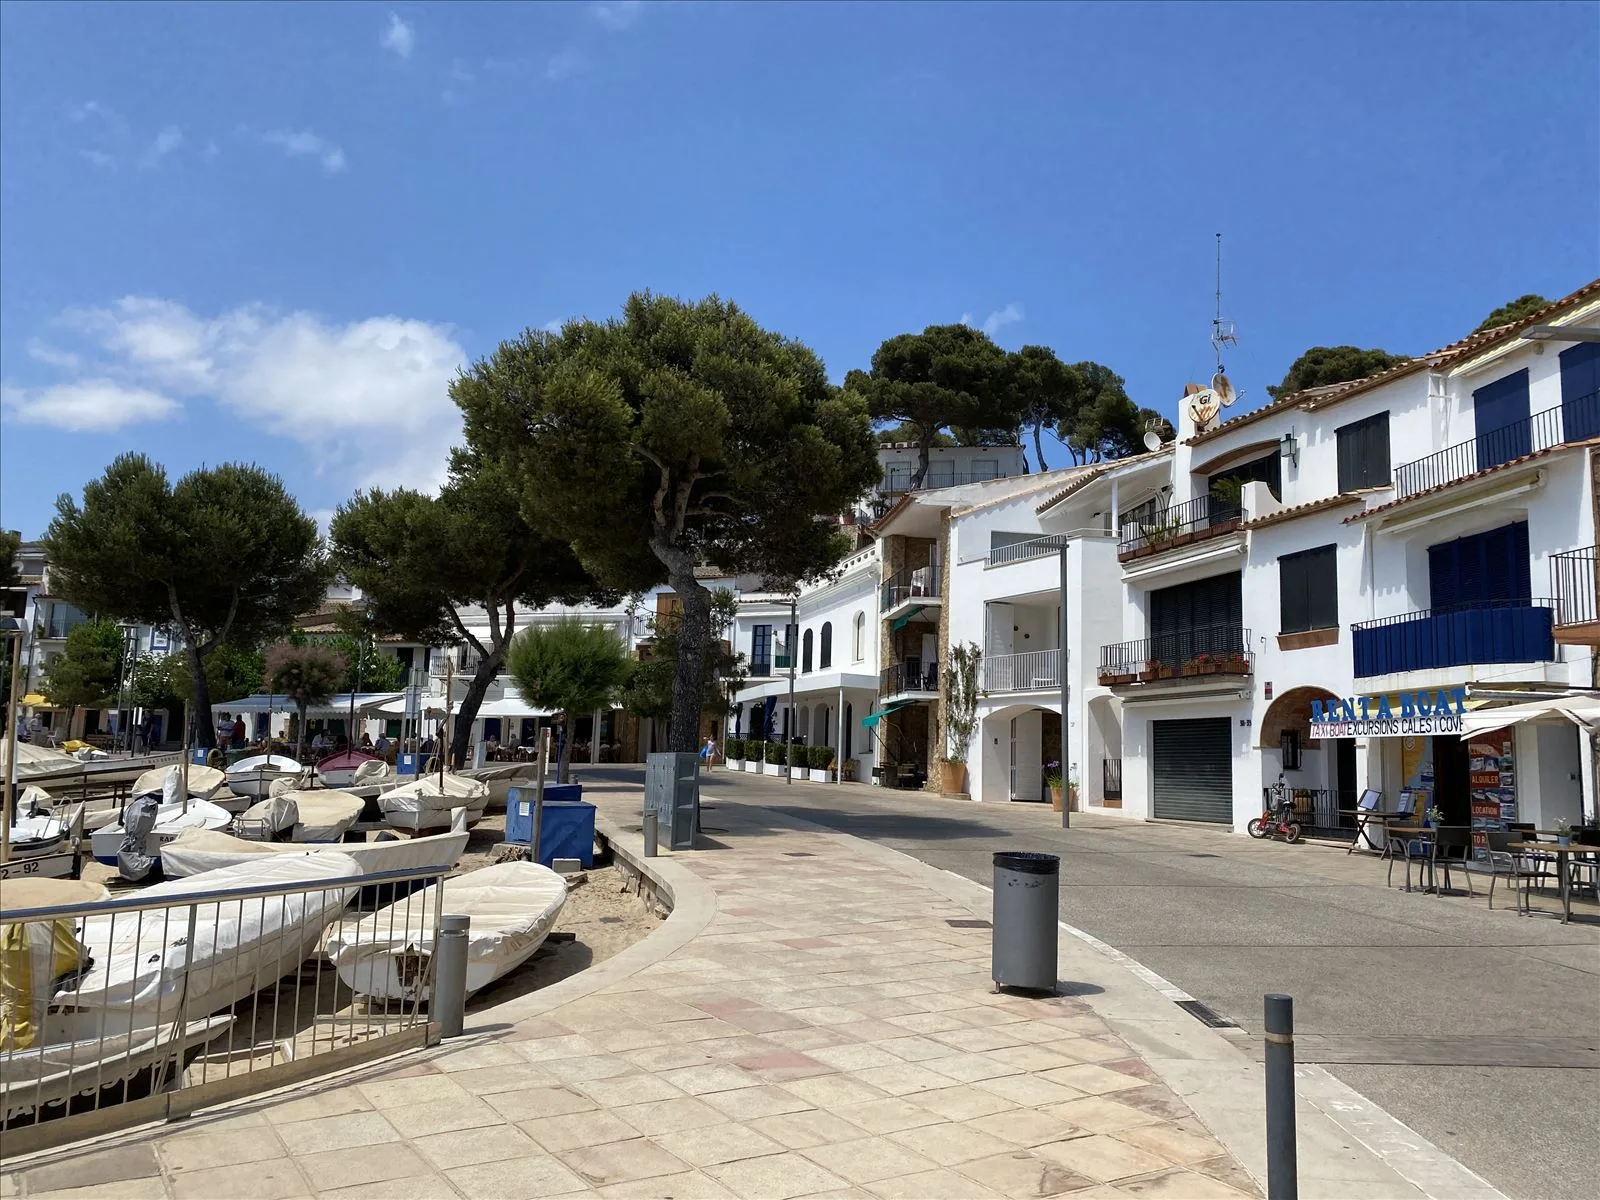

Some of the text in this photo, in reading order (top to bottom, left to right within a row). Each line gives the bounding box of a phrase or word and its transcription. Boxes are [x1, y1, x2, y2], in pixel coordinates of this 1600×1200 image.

[1311, 687, 1467, 723] RENT A BOAT
[1329, 723, 1346, 737] BOAT
[1347, 720, 1399, 736] EXCURSIONS
[1401, 718, 1432, 734] CALES
[1440, 716, 1463, 732] COVE
[1472, 806, 1498, 815] LOCATION
